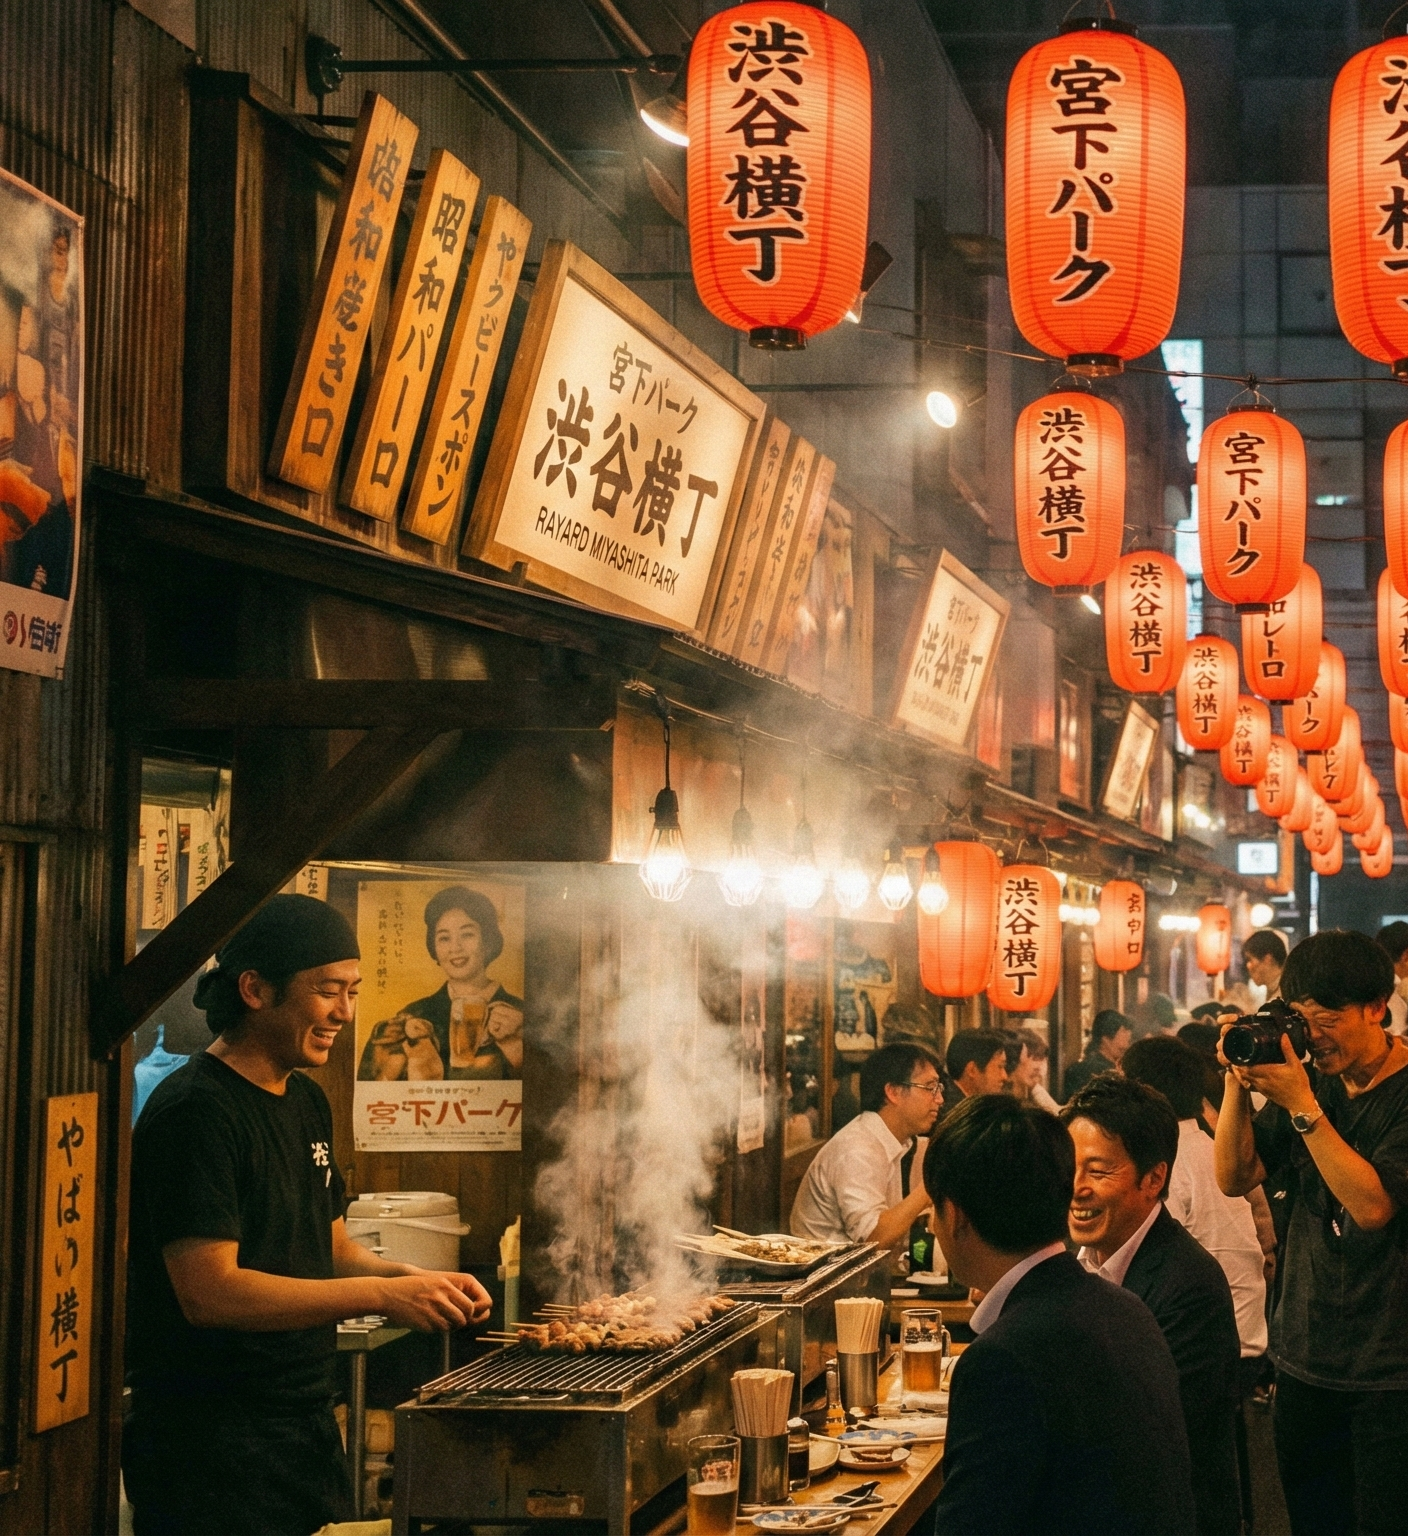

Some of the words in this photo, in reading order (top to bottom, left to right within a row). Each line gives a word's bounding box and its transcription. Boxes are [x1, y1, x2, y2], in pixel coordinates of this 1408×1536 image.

[724, 23, 810, 282] 渋谷横丁
[1049, 58, 1120, 302] 宮下パーク
[610, 341, 698, 434] 宮下パーク
[534, 378, 719, 558] 渋谷横丁
[1037, 409, 1086, 560] 渋谷横丁
[1224, 432, 1265, 577] 宮下パーク
[535, 505, 590, 552] RAYARD
[589, 532, 650, 583] MIYASHITA
[650, 560, 680, 596] PARK
[1129, 562, 1164, 674] 渋谷横丁
[1003, 877, 1040, 997] 渋谷横丁
[367, 1099, 522, 1127] 宮下パーク
